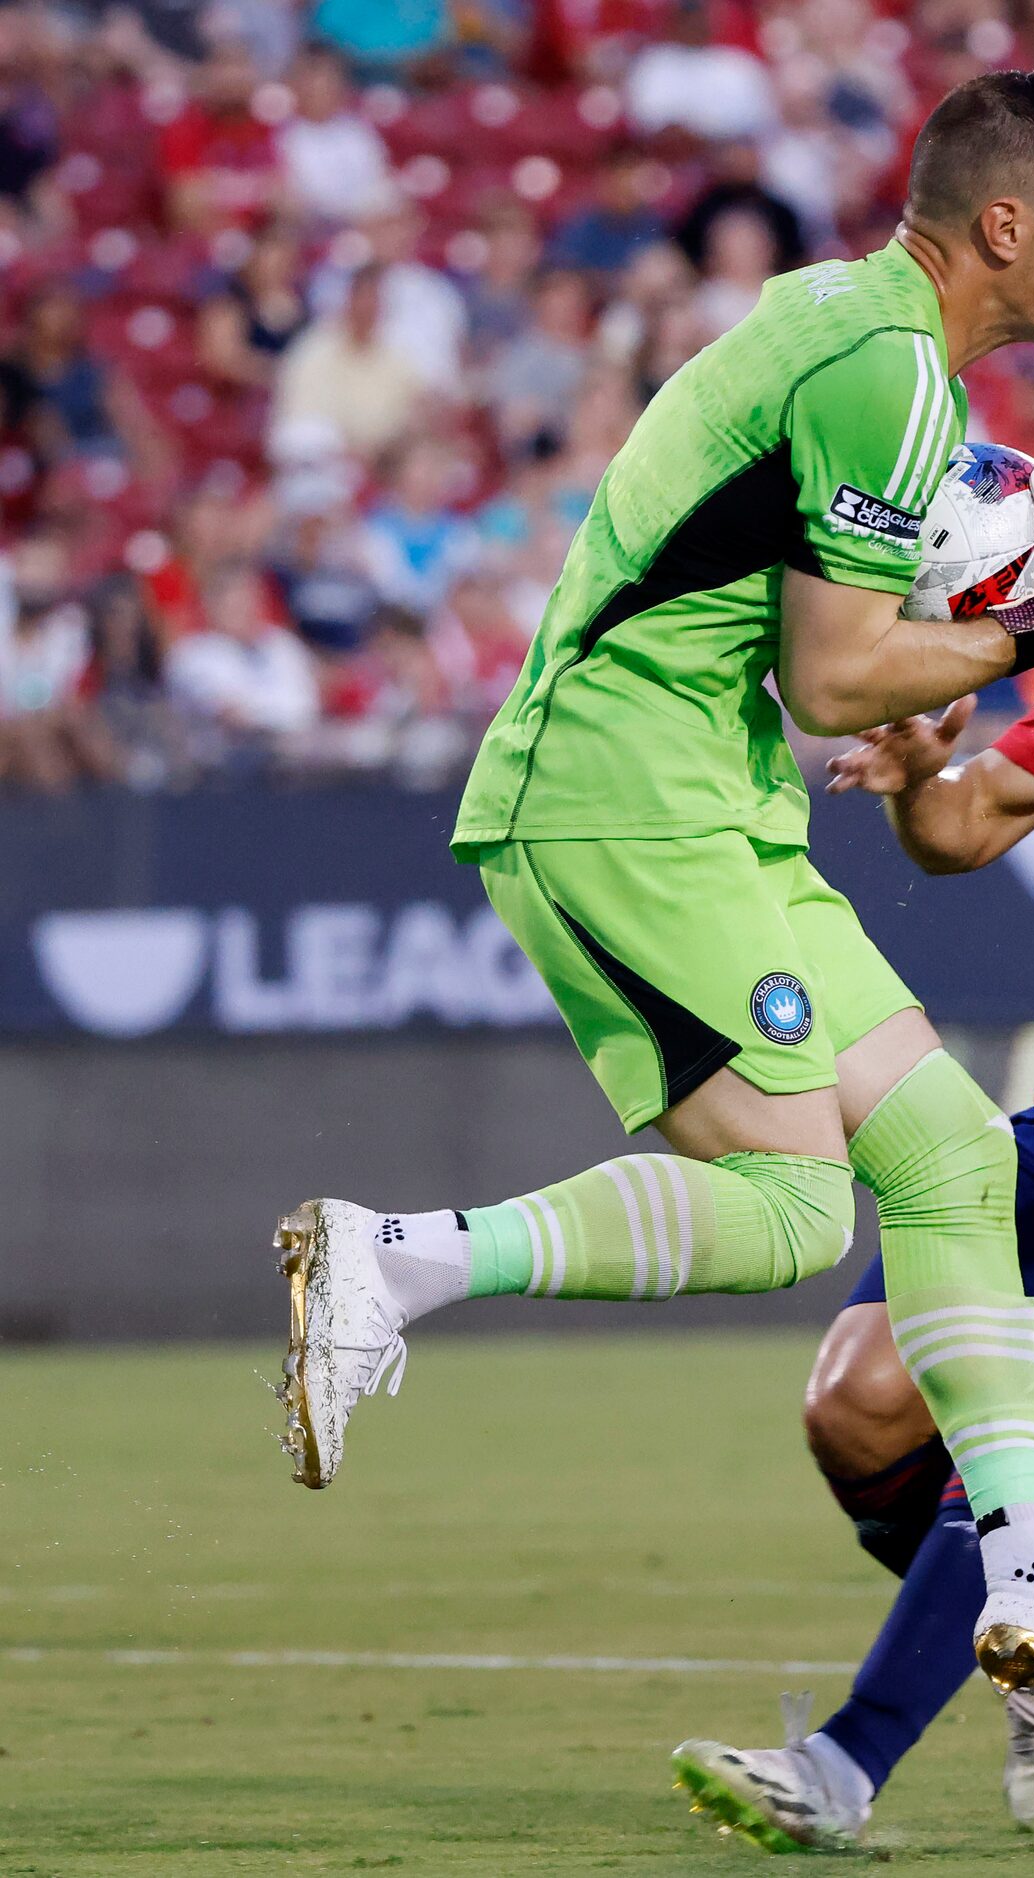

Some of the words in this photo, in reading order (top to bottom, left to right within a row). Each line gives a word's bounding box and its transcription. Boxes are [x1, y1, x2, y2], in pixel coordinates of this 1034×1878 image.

[856, 510, 890, 529] CUP
[860, 499, 920, 532] LEAGUES
[755, 977, 801, 1003] CHARLOTTE
[767, 1027, 801, 1040] FOOTBALL
[800, 1017, 811, 1034] CLUB
